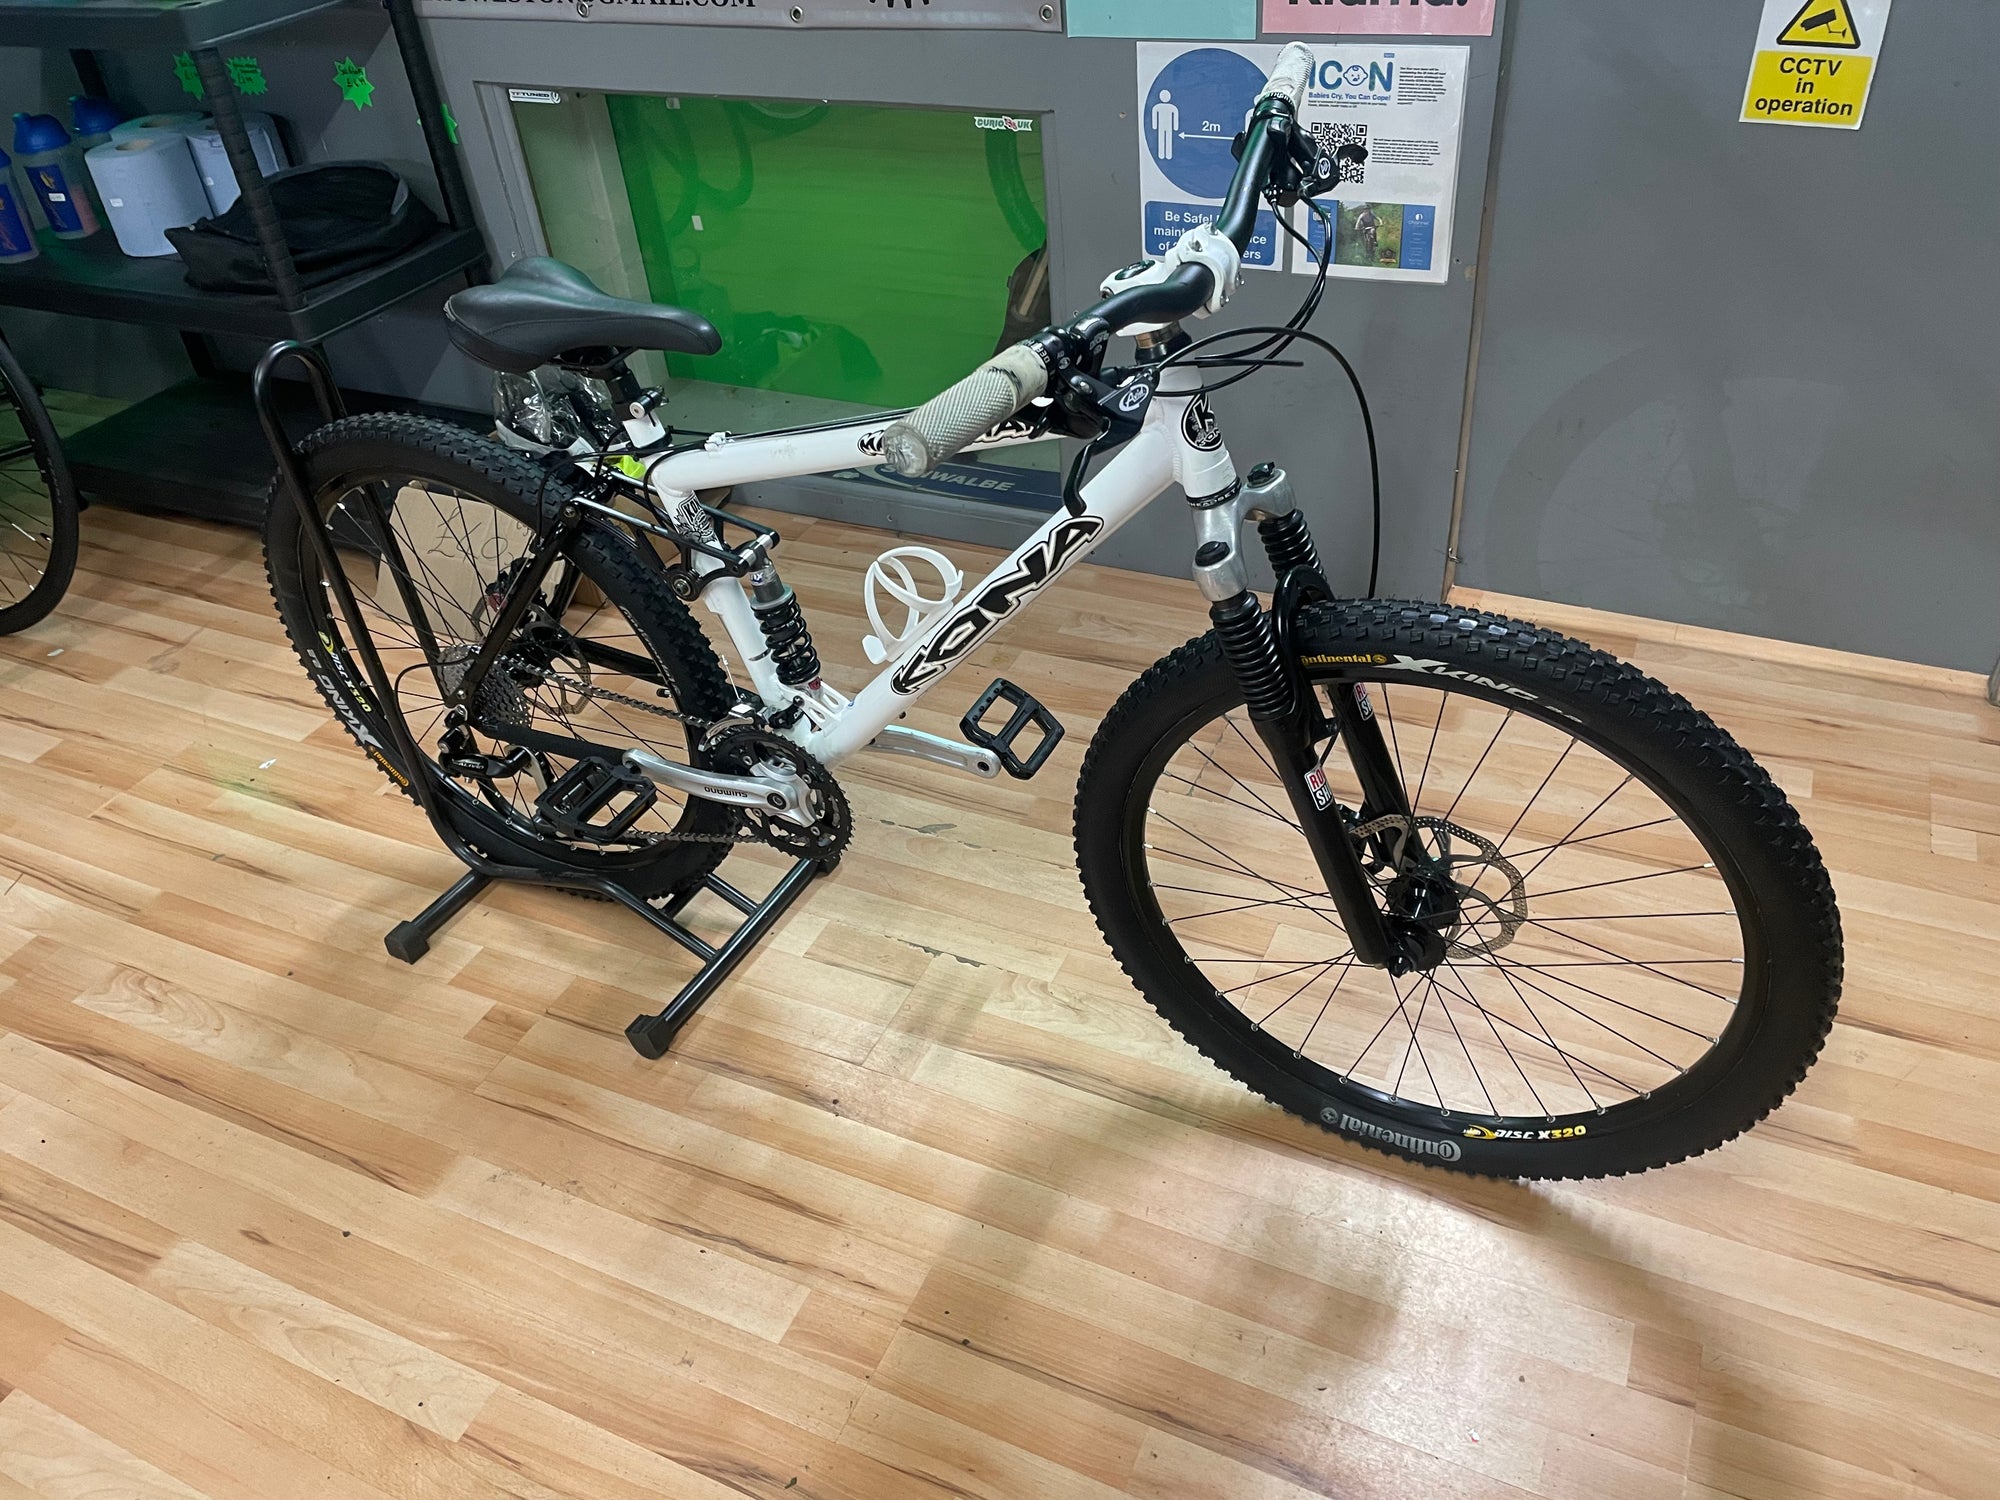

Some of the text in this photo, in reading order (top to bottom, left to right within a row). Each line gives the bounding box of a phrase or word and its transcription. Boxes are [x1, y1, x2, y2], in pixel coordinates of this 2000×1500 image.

[1780, 57, 1843, 76] CCTV
[1795, 78, 1815, 94] in
[1755, 97, 1853, 117] operation
[1201, 121, 1221, 132] 2m
[1164, 211, 1180, 222] Be
[1158, 241, 1171, 251] of
[880, 463, 1015, 492] SWALBE
[891, 516, 1105, 695] KONA
[1300, 653, 1372, 666] ontinental
[344, 680, 372, 713] X320
[704, 785, 748, 798] SHIMANO
[1339, 1113, 1462, 1162] Continental
[1495, 1129, 1535, 1140] DISC
[1537, 1125, 1587, 1140] X320
